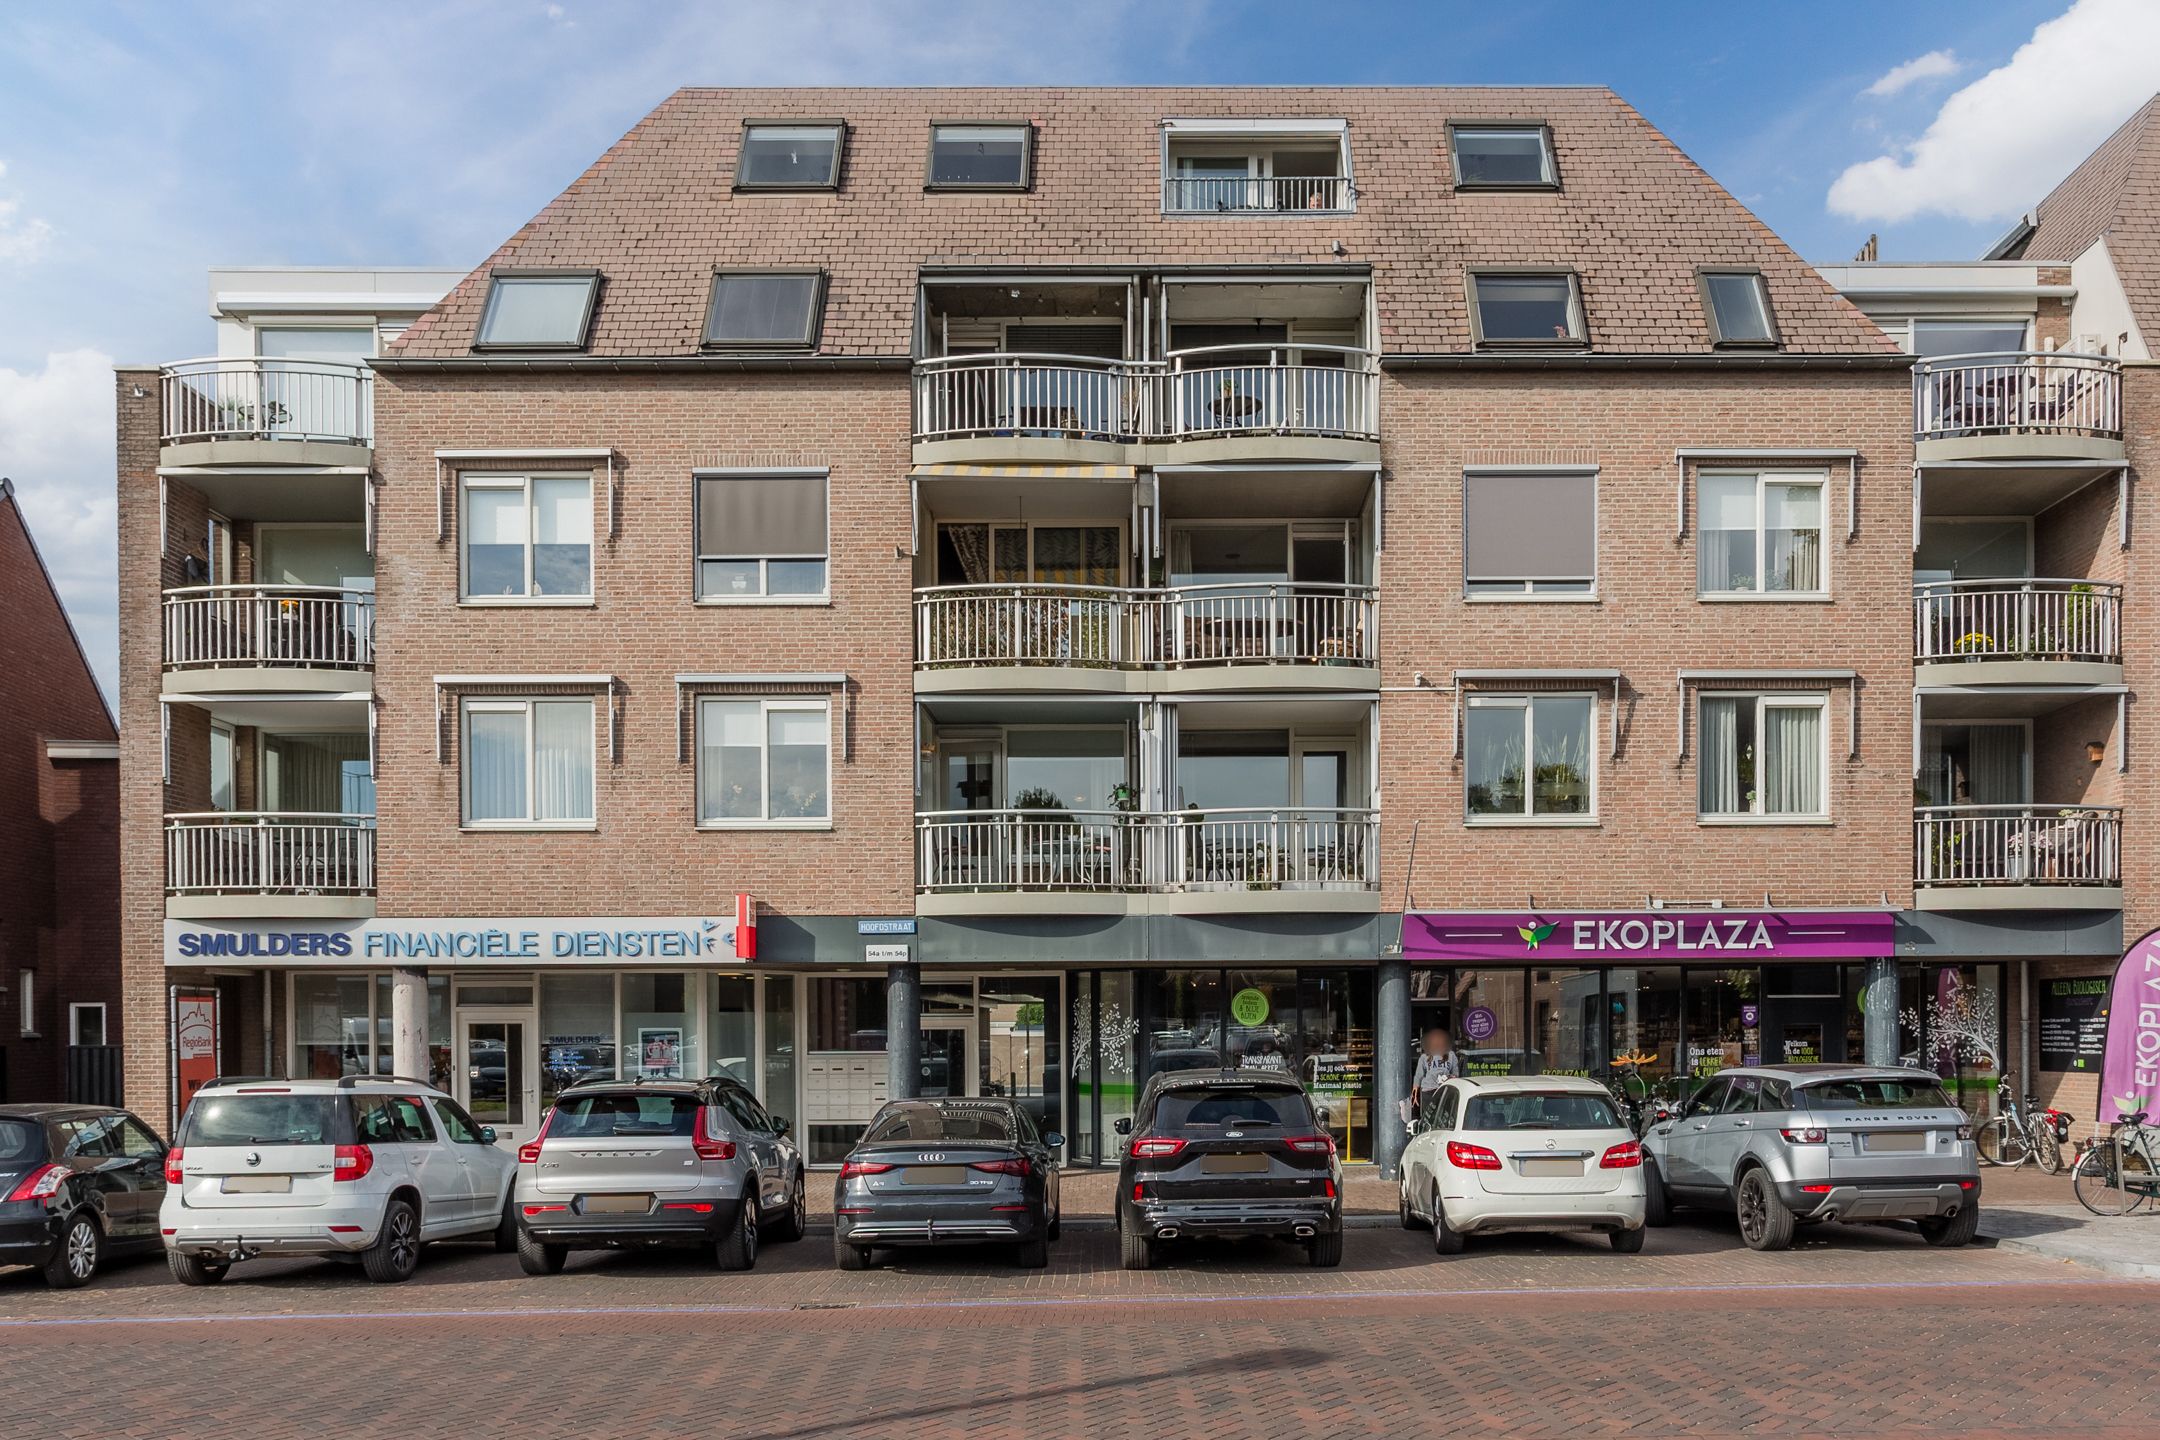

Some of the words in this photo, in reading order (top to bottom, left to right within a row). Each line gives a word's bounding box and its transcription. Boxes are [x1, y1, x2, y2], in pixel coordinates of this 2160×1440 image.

[861, 922, 912, 931] HOOFDSTRAAT
[1573, 919, 1775, 950] EKOPLAZA
[178, 932, 353, 957] SMULDERS
[364, 929, 540, 957] FINANCIËLE
[552, 930, 701, 957] DIENSTEN
[895, 950, 907, 958] 54p
[2052, 981, 2072, 995] ALLEEN
[2073, 980, 2107, 995] BIOLOGISCH
[182, 1036, 212, 1050] RegioBank
[549, 1035, 601, 1044] SMULDERS
[1689, 1047, 1705, 1056] Ons
[1706, 1047, 1725, 1056] eten
[1241, 1054, 1282, 1065] TRANSPARANT
[1691, 1057, 1699, 1066] is
[1343, 1082, 1362, 1090] plastic
